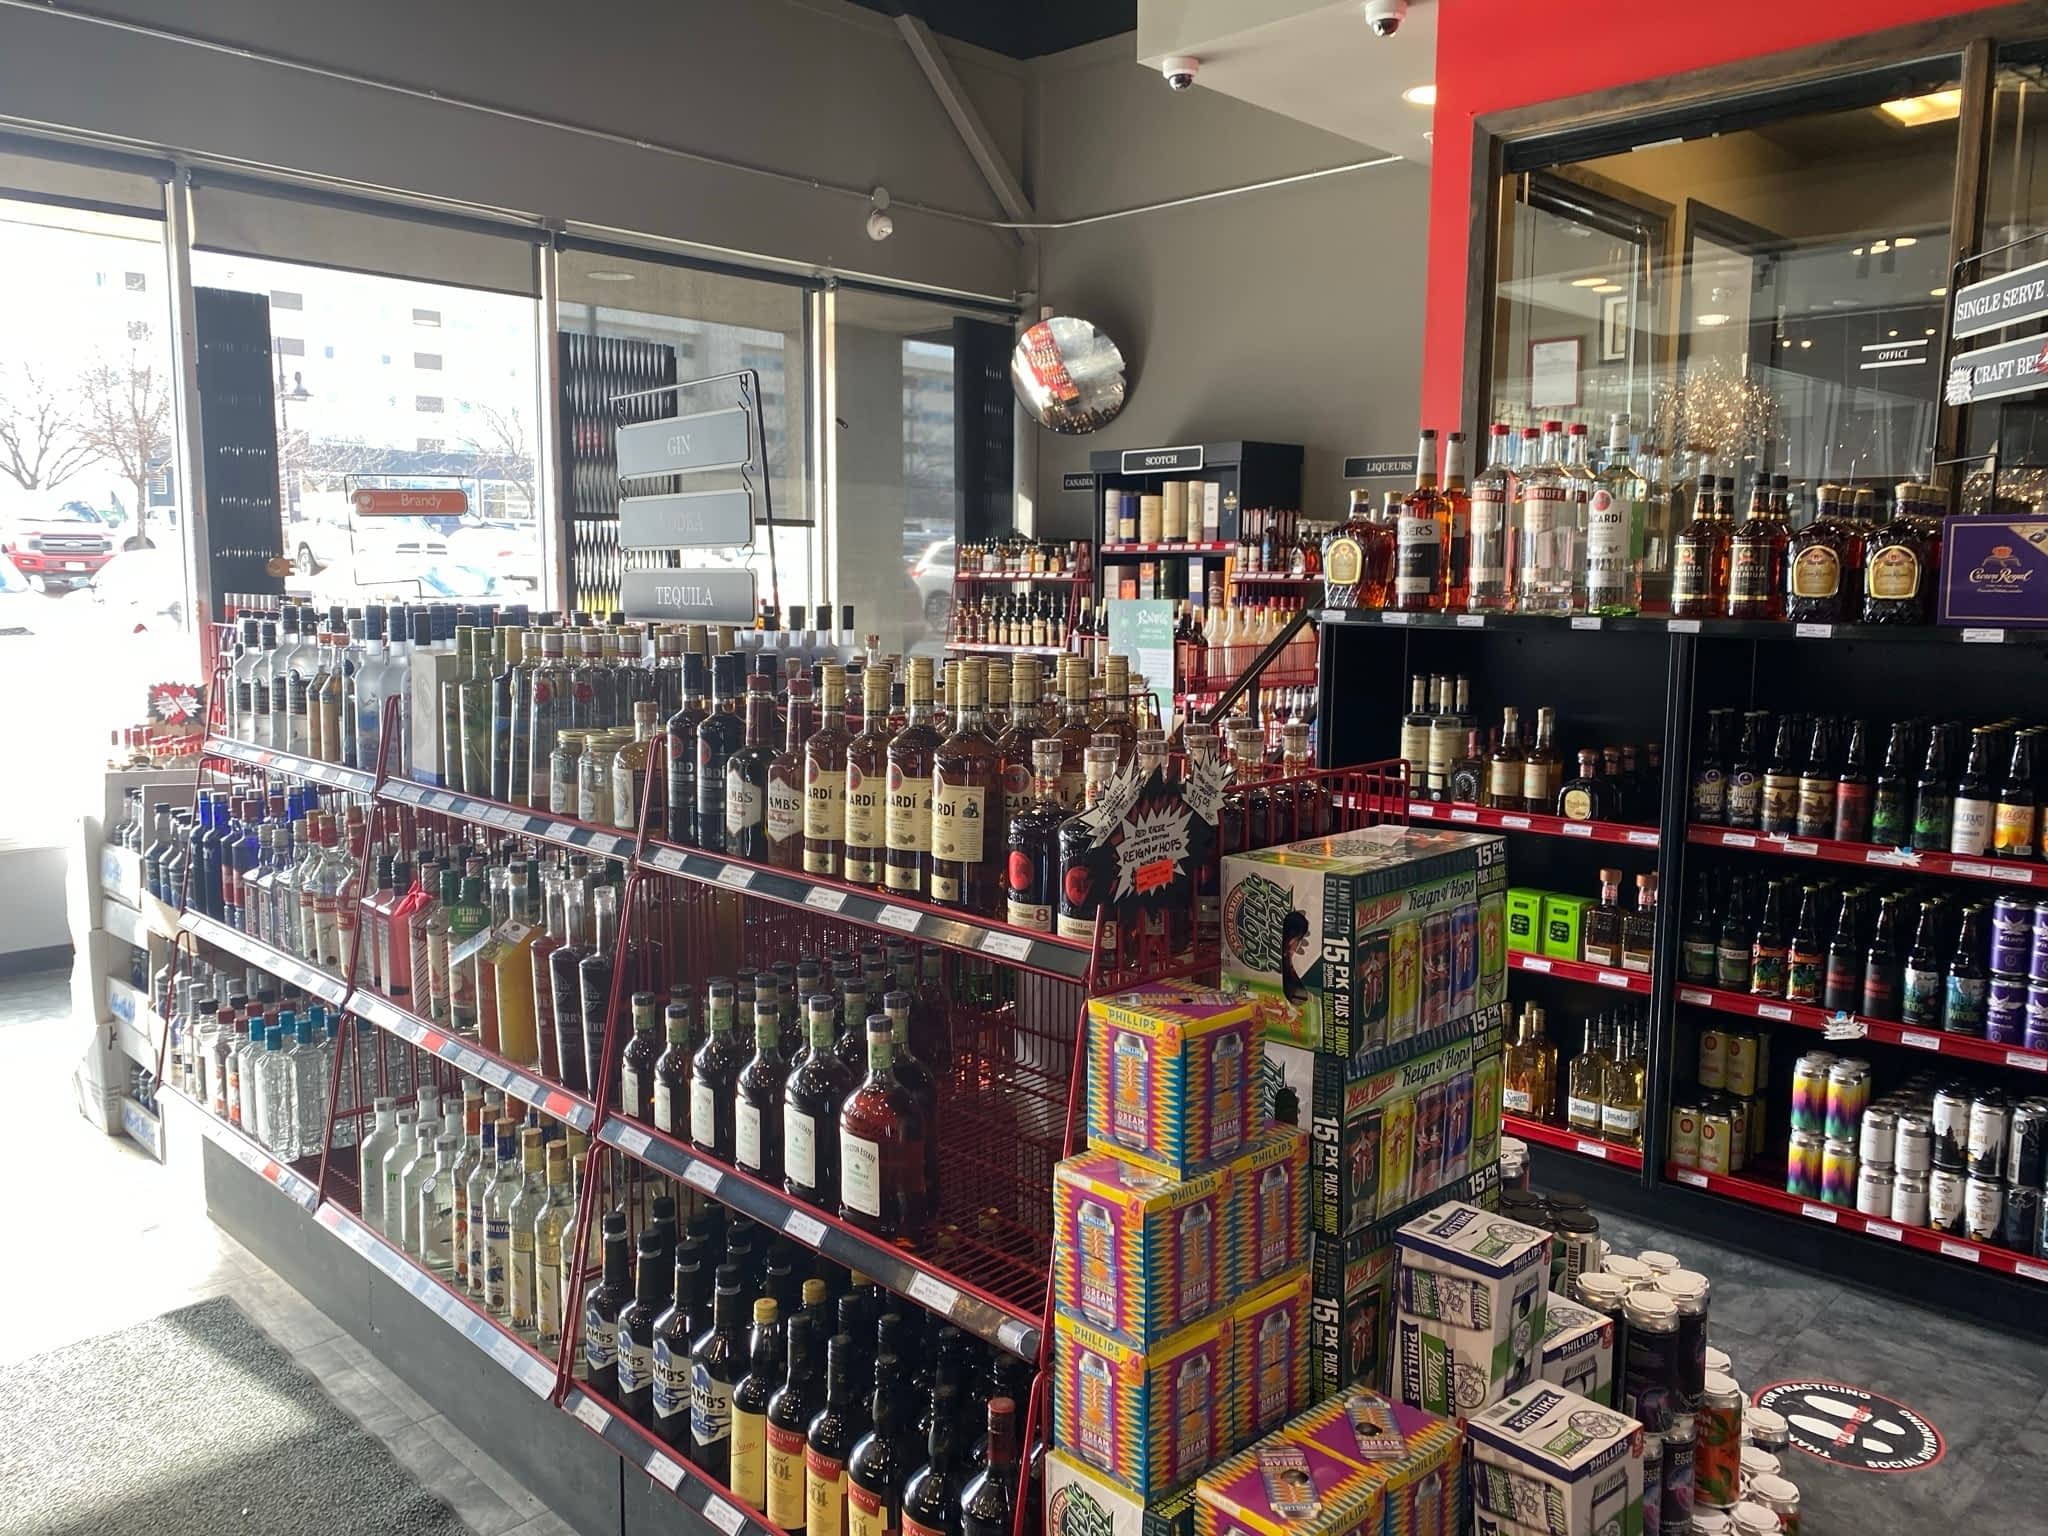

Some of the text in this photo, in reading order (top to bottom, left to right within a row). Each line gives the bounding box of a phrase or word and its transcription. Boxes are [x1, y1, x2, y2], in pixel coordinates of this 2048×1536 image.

[1957, 280, 2045, 322] SINGLE SERVE
[1878, 350, 1908, 361] OFFICE
[1974, 358, 2014, 385] CRAFT
[667, 435, 690, 456] GIN
[1145, 455, 1178, 466] SCOTCH
[1366, 461, 1412, 472] LIQUEURS
[1065, 478, 1094, 488] CANADIA
[401, 493, 441, 509] Brandy
[1969, 568, 2034, 584] Crown Royal
[656, 586, 713, 606] TEQUILA
[769, 797, 801, 811] AMB'S
[808, 785, 832, 800] ARDÍ
[849, 792, 876, 807] ARDÍ
[891, 792, 917, 808] ARDÍ
[1122, 839, 1182, 864] REIGN HOPS
[1475, 845, 1491, 868] 15
[1493, 840, 1504, 855] PK
[1324, 879, 1336, 933] EDITION
[1338, 879, 1350, 934] LIMITED
[1408, 887, 1440, 912] Reign
[1449, 879, 1474, 899] Hops
[1036, 908, 1048, 922] 8
[1228, 890, 1242, 951] MIXER PACK
[1103, 924, 1114, 939] 8
[1322, 936, 1350, 962] 15
[1335, 965, 1349, 989] PK
[1335, 993, 1349, 1017] PLUS
[1108, 1008, 1156, 1031] PHILLIPS
[1470, 1004, 1499, 1033] 15 PK
[1166, 1026, 1177, 1040] 4
[1335, 1026, 1349, 1058] BONUS
[1400, 1063, 1438, 1087] Reign
[1444, 1048, 1470, 1071] Hops
[1118, 1111, 1145, 1127] DREAM
[1213, 1119, 1238, 1134] DREAM
[1312, 1117, 1339, 1143] 15
[1252, 1142, 1293, 1168] PHILLIPS
[1325, 1144, 1338, 1169] PK
[1171, 1179, 1216, 1204] PHILLIPS
[1324, 1171, 1338, 1196] PLUS
[1468, 1163, 1498, 1196] 15 PK
[1131, 1201, 1140, 1214] 4
[1324, 1203, 1338, 1236] BONUS
[1263, 1239, 1286, 1255] DREAM
[1513, 1245, 1542, 1270] PHILLIPS
[1568, 1246, 1579, 1269] STOUT
[1085, 1286, 1113, 1304] DREAM
[1183, 1282, 1208, 1298] DREAM
[1312, 1296, 1339, 1323] 15
[586, 1330, 613, 1344] AMB'S
[1074, 1324, 1121, 1359] PHILLIPS
[1325, 1325, 1338, 1349] PK
[1562, 1330, 1599, 1355] PHILLIPS
[618, 1347, 644, 1367] AMB'S
[1130, 1358, 1140, 1370] 4
[1324, 1351, 1338, 1375] PLUS
[1408, 1332, 1420, 1400] PHILLIPS
[652, 1367, 685, 1383] AMB'S
[1427, 1347, 1445, 1402] Pilsner
[1446, 1352, 1454, 1412] IMPLOSION
[691, 1389, 726, 1409] AMB'S
[1261, 1390, 1286, 1410] DREAM
[1760, 1383, 1872, 1407] FOR PRACTICING
[1515, 1396, 1559, 1431] PHILLIPS
[1083, 1429, 1110, 1449] DREAM
[1180, 1438, 1208, 1457] DREAM
[1361, 1439, 1400, 1449] DREAM
[1635, 1431, 1642, 1444] 6
[1865, 1410, 1937, 1469] SOCIAL DISTANCING
[1408, 1449, 1448, 1476] PHILLIPS
[1589, 1438, 1629, 1472] PHILLIPS
[1327, 1502, 1369, 1535] PHILLIPS
